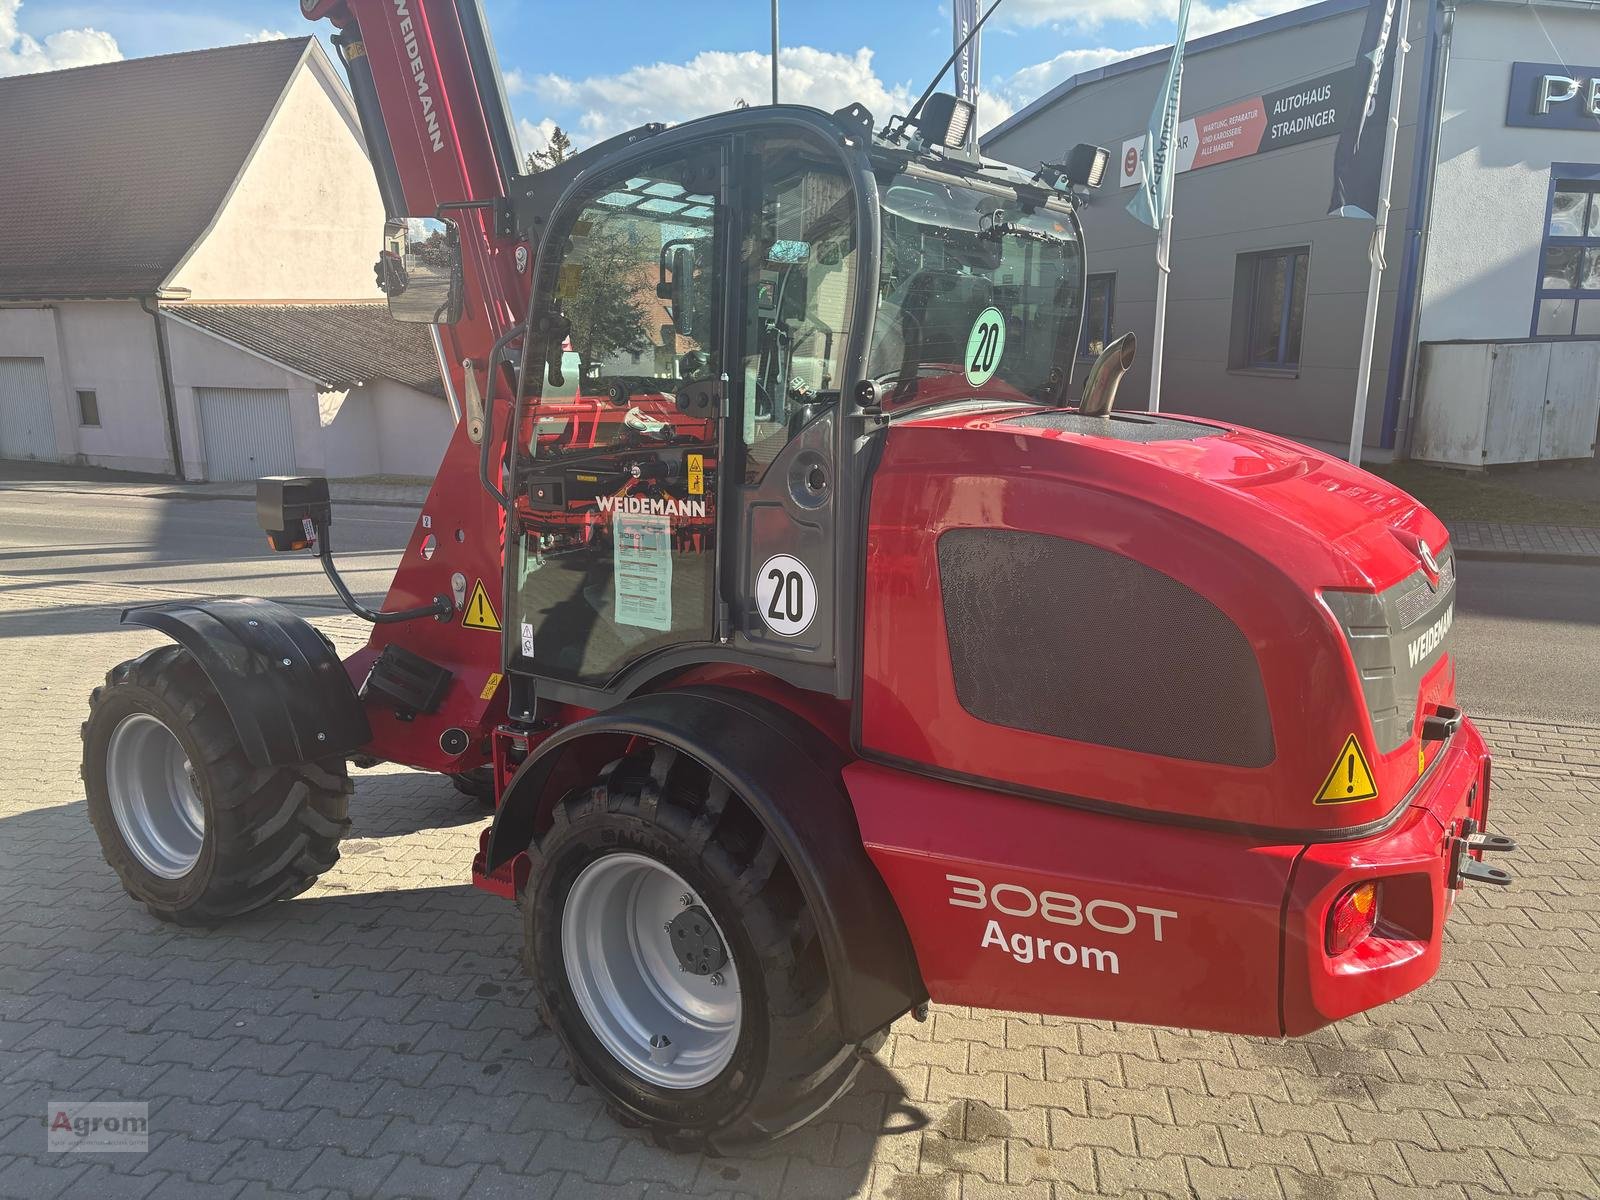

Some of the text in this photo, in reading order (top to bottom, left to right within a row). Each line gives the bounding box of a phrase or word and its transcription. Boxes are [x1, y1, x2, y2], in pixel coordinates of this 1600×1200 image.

[394, 0, 444, 152] WEIDEMANN
[1229, 109, 1258, 126] REPARATUR
[1273, 84, 1331, 115] AUTOHAUS
[1271, 108, 1336, 139] STRADINGER
[1201, 141, 1234, 155] ALLE MARKEN
[970, 322, 999, 372] 20
[595, 495, 706, 518] WEIDEMANN
[768, 568, 803, 622] 20
[946, 874, 1178, 942] 3080T
[981, 919, 1119, 974] Agrom
